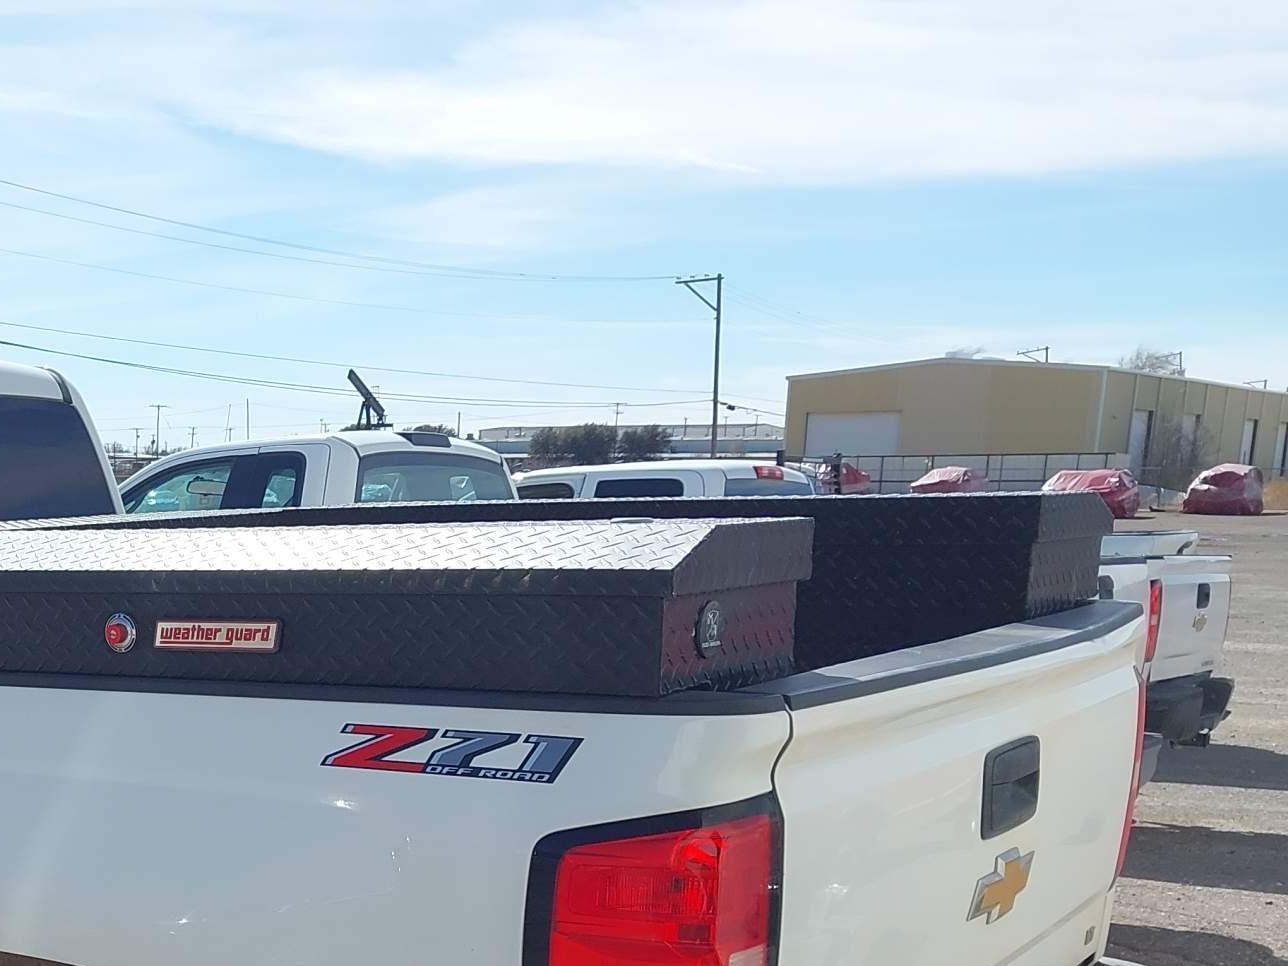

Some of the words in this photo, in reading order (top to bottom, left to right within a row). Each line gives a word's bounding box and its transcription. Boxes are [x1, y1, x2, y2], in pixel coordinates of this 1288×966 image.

[160, 625, 222, 641] weather
[226, 625, 270, 645] guard
[320, 723, 585, 784] Z71
[425, 765, 472, 776] OFF
[478, 769, 550, 782] ROAD
